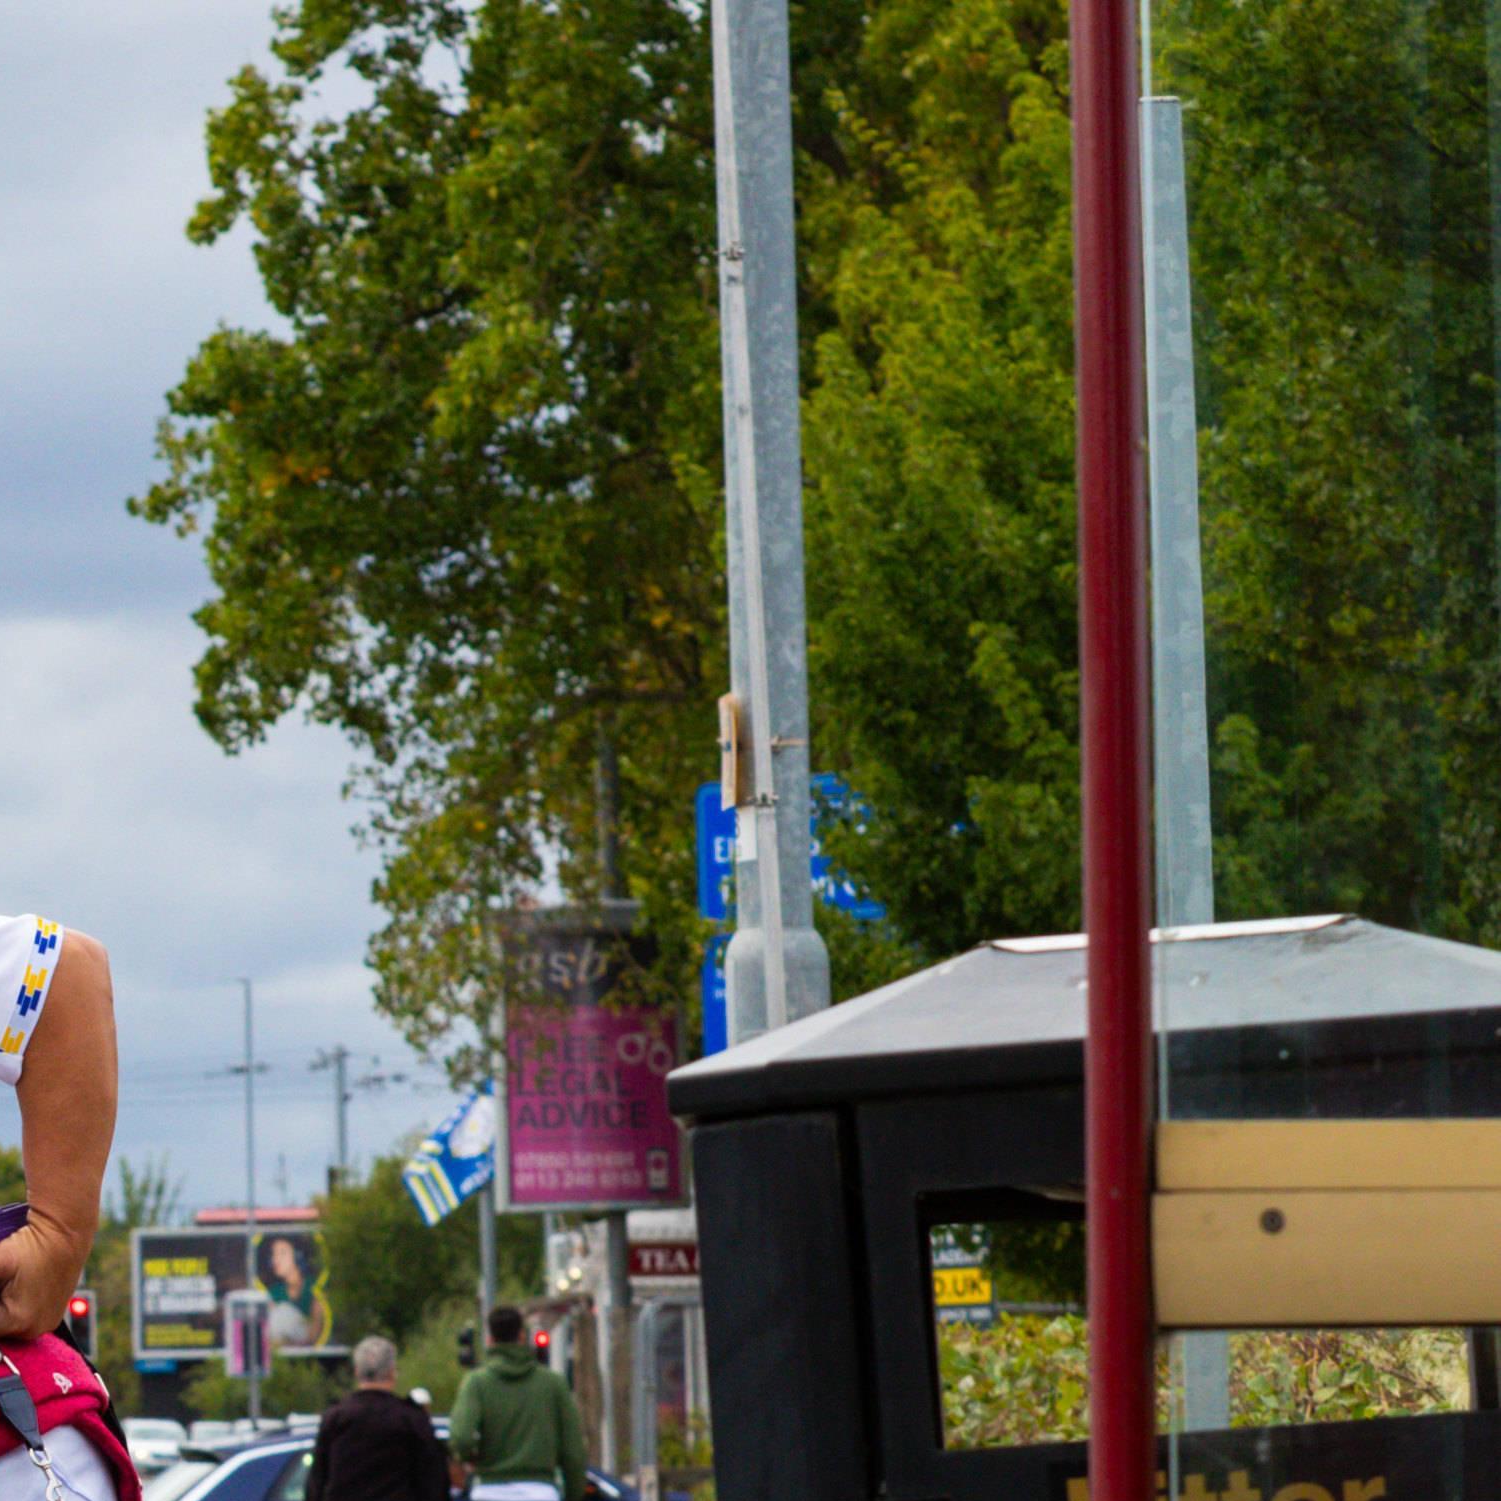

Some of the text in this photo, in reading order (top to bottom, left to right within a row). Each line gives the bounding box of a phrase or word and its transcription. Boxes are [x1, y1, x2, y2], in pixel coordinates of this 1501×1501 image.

[517, 1068, 632, 1096] LEGAL
[516, 1101, 649, 1129] ADVICE
[637, 1250, 688, 1270] TEA
